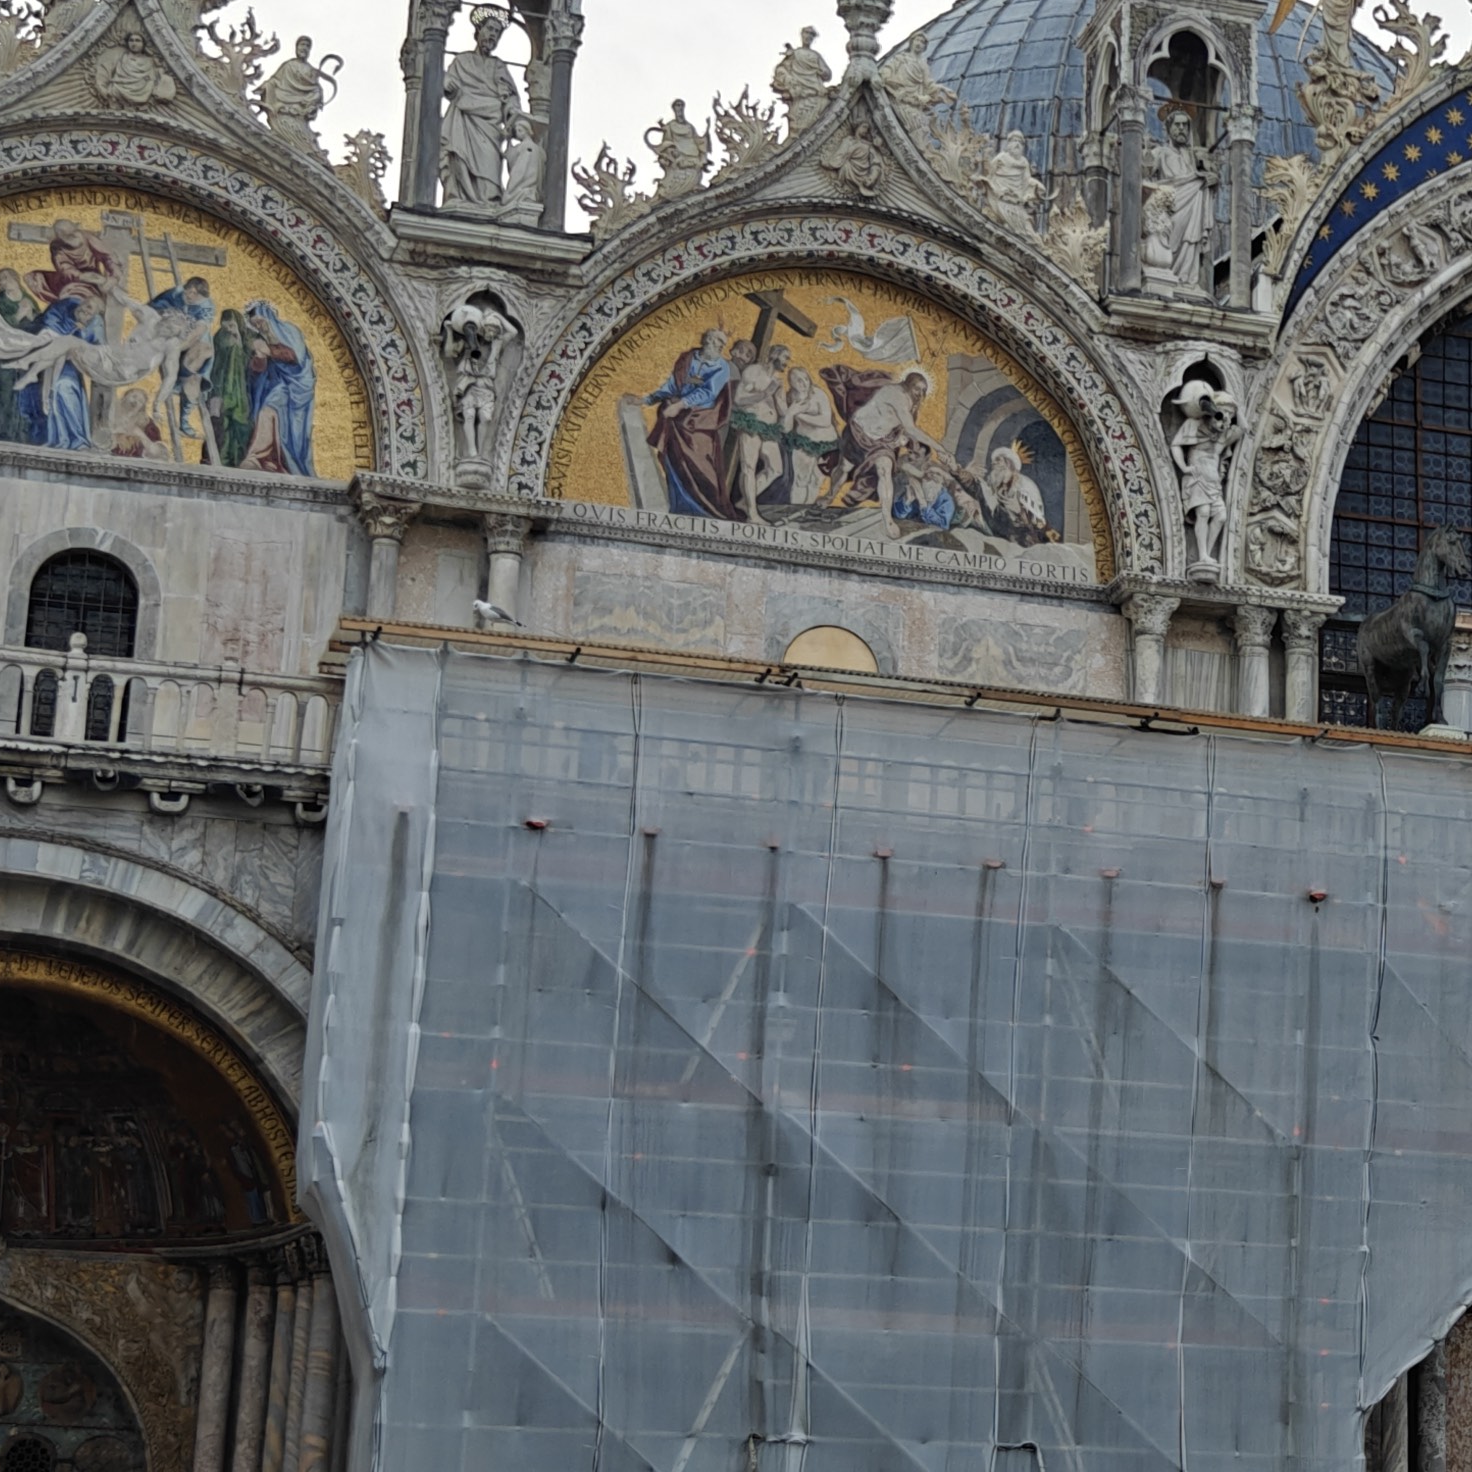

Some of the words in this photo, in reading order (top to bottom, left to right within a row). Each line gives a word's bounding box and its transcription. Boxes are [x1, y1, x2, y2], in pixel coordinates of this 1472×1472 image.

[550, 418, 583, 482] VISITAT
[621, 303, 685, 354] REGNVM
[636, 511, 719, 534] FRACTIS
[810, 532, 885, 556] SPOLIAT
[898, 544, 925, 562] ME
[935, 550, 1007, 572] CAMPIO
[1019, 561, 1089, 583] FORTIS
